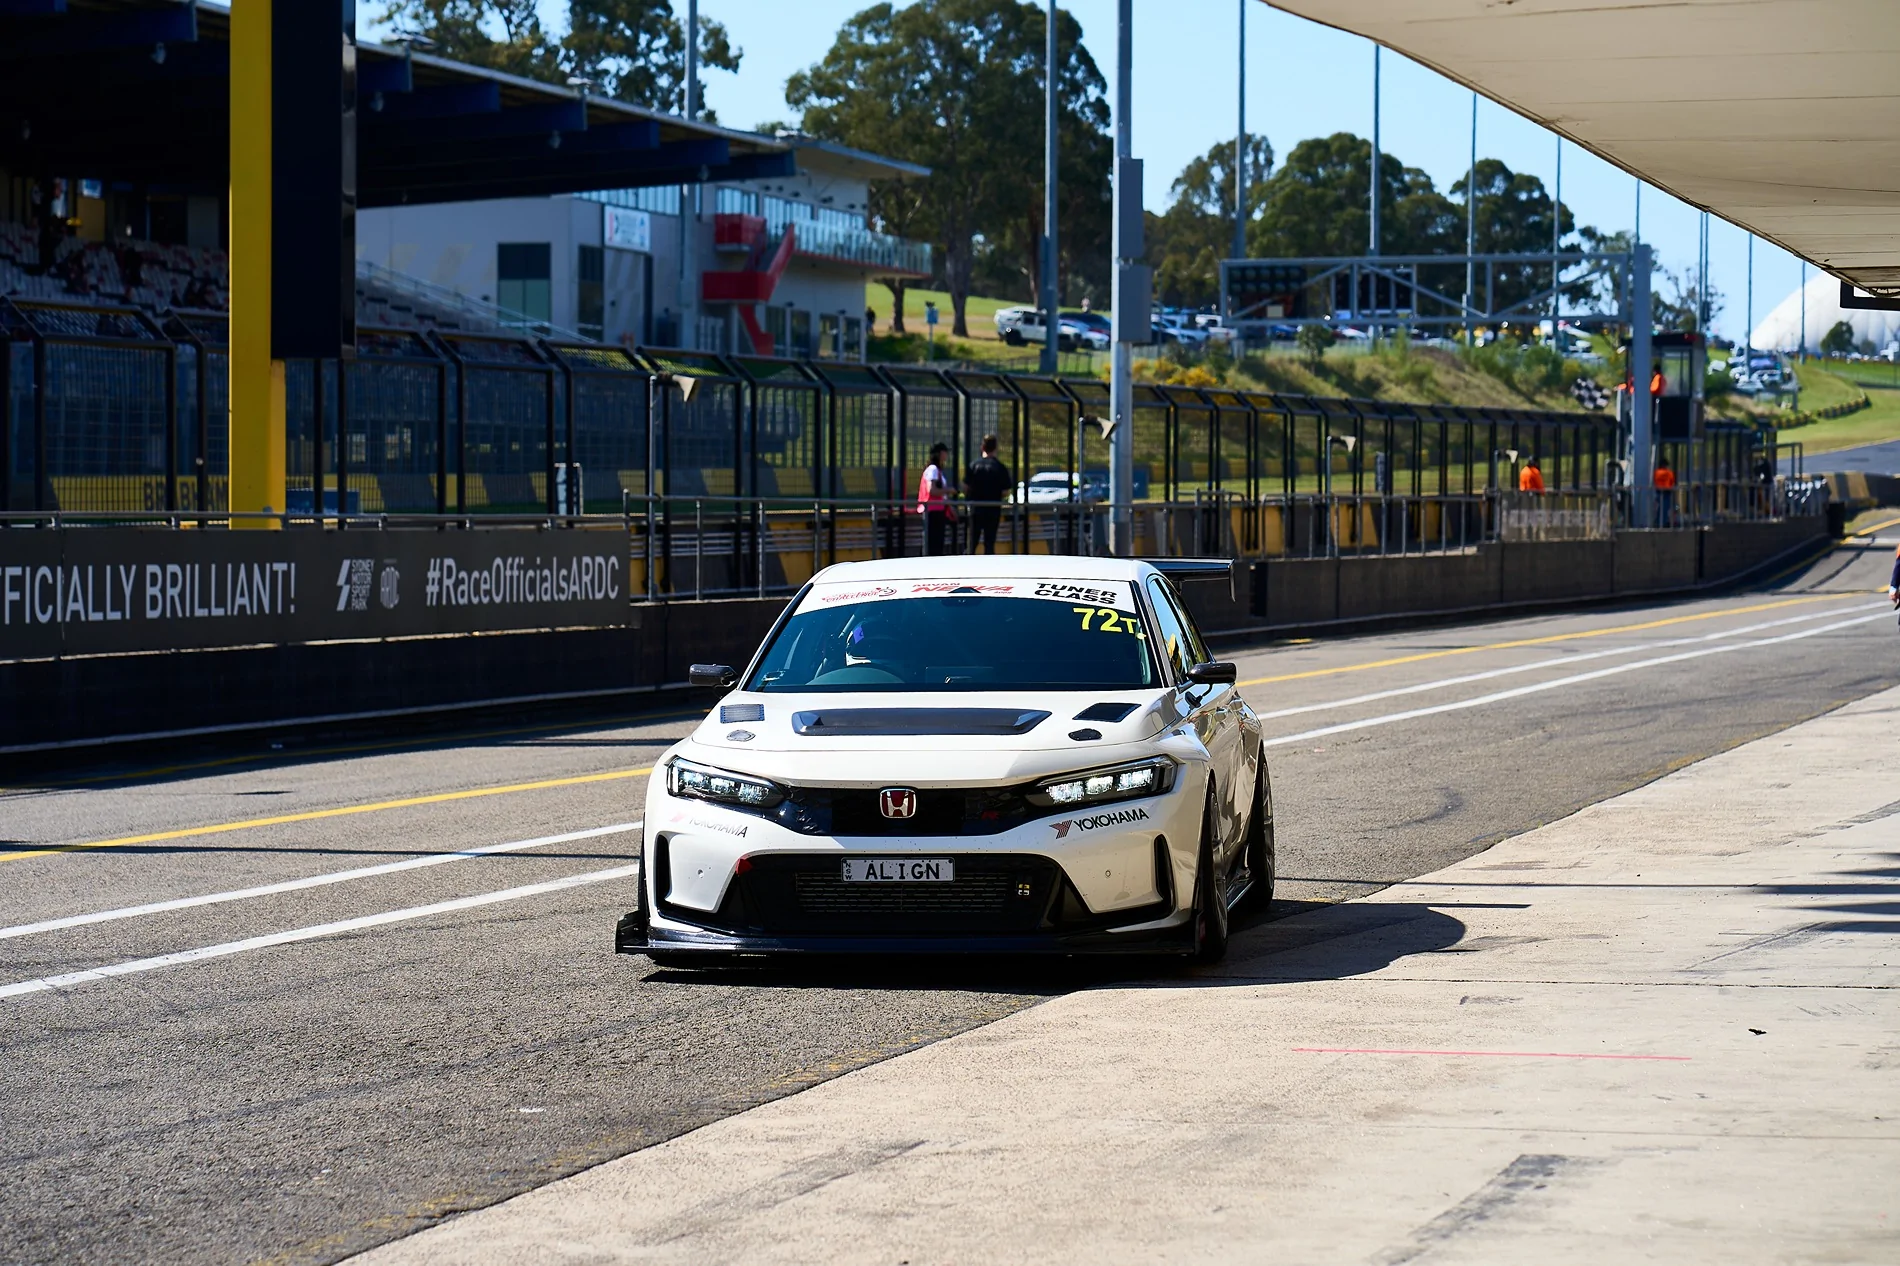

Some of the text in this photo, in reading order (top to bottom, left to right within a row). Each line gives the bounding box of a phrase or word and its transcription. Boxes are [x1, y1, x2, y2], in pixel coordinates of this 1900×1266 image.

[351, 559, 375, 572] SYDNEY
[351, 572, 373, 585] MOTOR
[426, 555, 619, 606] #RaceOfficialsARDC
[0, 562, 296, 625] FICIALLY BRILLIANT!
[351, 585, 371, 598] SPORT
[1034, 589, 1117, 604] CLASS
[1036, 582, 1118, 598] TUNER
[351, 598, 368, 611] PARK
[1073, 808, 1150, 831] YOKOHAMA
[865, 863, 940, 880] ALIGN
